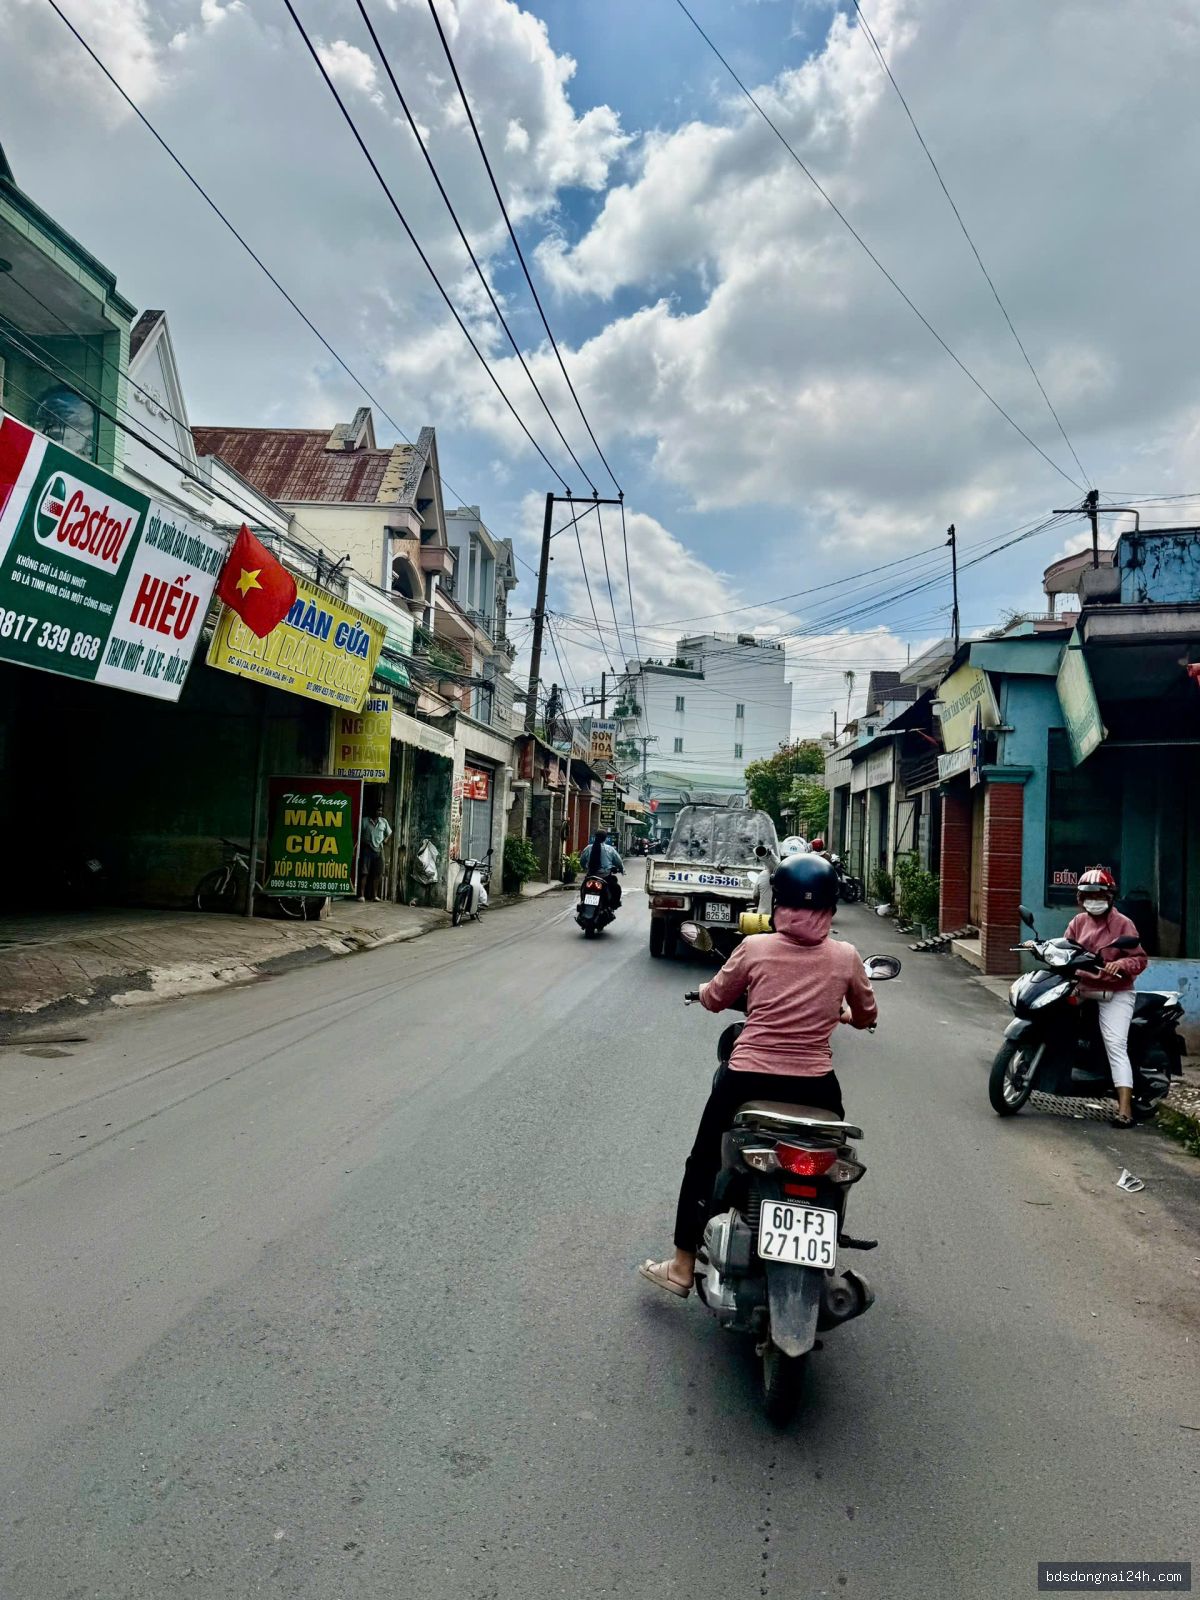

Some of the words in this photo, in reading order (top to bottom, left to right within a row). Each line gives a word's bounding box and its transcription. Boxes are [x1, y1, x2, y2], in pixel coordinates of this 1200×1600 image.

[57, 490, 132, 564] Castrol
[16, 554, 39, 571] KHÔNG
[11, 570, 21, 582] ĐÓ
[30, 577, 45, 591] TINH
[45, 582, 58, 596] HOA
[129, 573, 200, 640] HIẾU
[284, 598, 333, 642] MÀN
[334, 620, 370, 660] CỬA
[37, 621, 71, 653] 339
[70, 631, 100, 661] 868
[276, 633, 320, 677] DÁN
[318, 651, 369, 695] TƯỜNG
[341, 718, 387, 740] NGỌC
[341, 741, 385, 764] PHÁT
[282, 793, 307, 804] Thu
[312, 794, 348, 809] Trang
[284, 807, 343, 828] MÀN
[285, 830, 339, 855] CỬA
[273, 856, 293, 877] XỐP
[295, 859, 315, 878] DÁN
[317, 859, 348, 879] TƯỜNG
[1053, 868, 1077, 885] BÚN
[270, 880, 285, 888] 0909
[286, 880, 296, 888] 453
[298, 881, 308, 889] 792
[312, 881, 327, 890] 0938
[339, 883, 350, 891] 119
[667, 872, 693, 882] 51C
[698, 874, 739, 887] 62536
[711, 903, 726, 912] 51C
[772, 1206, 825, 1236] 60-F3
[763, 1232, 831, 1264] 271.05
